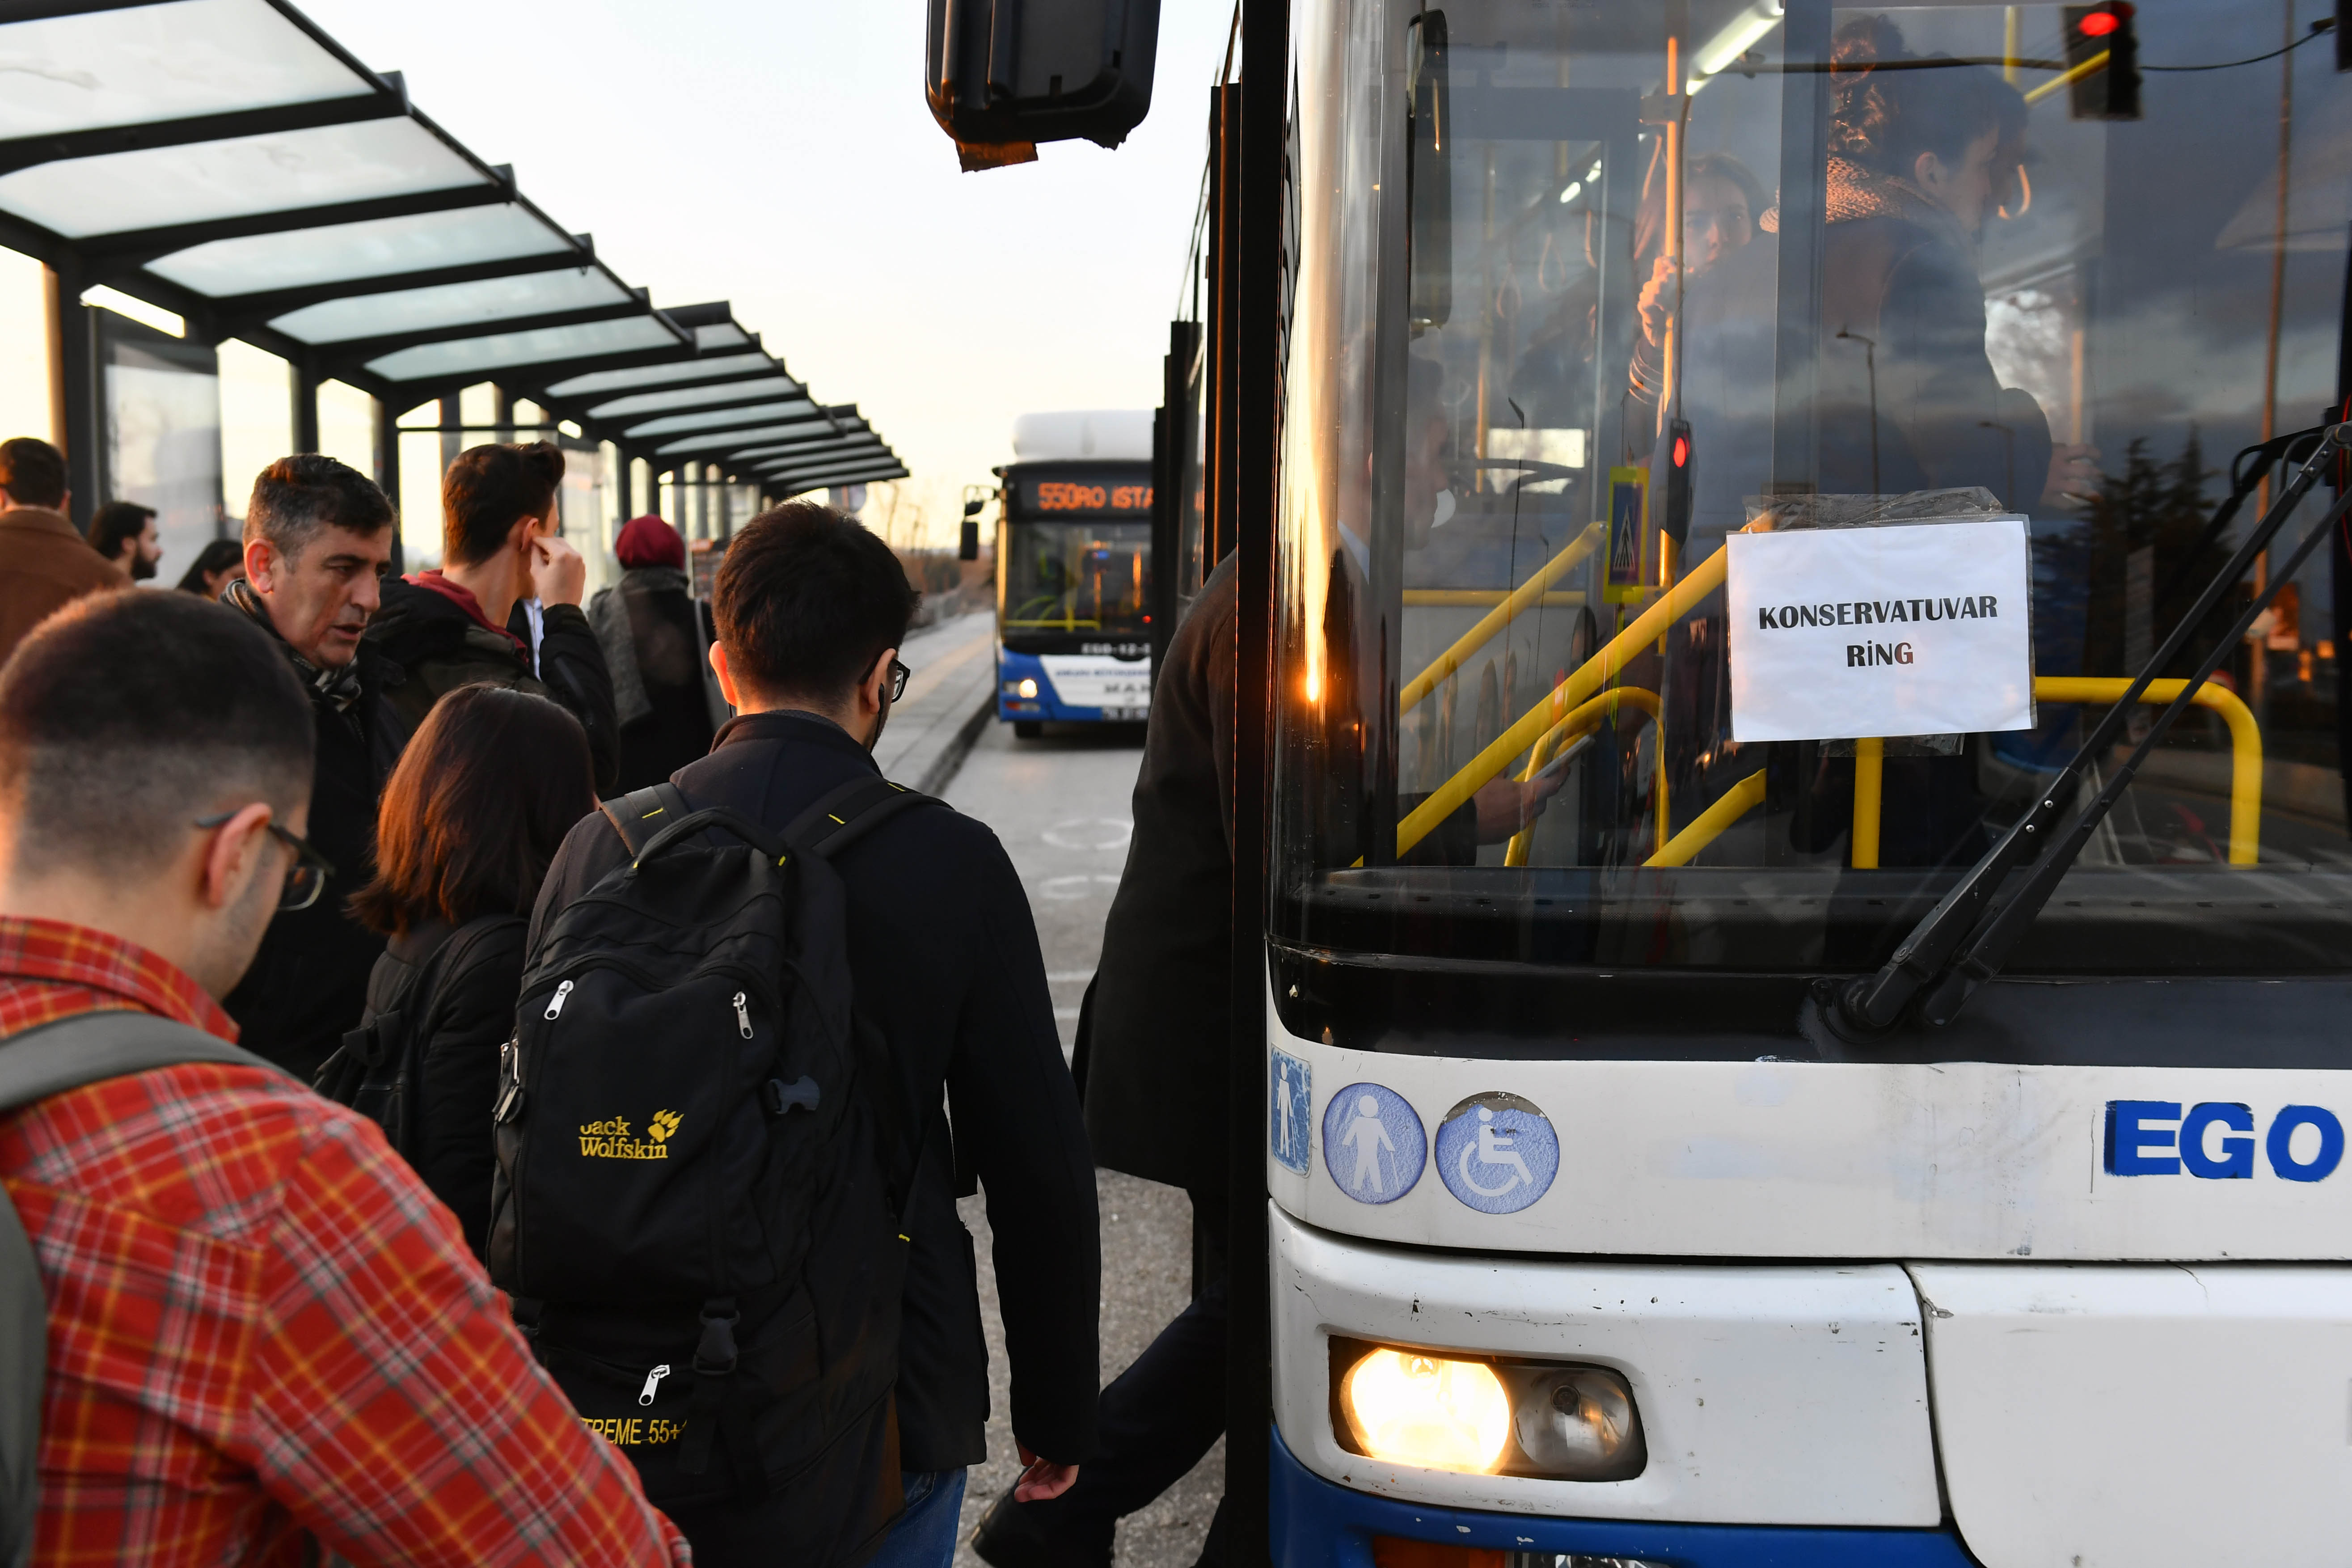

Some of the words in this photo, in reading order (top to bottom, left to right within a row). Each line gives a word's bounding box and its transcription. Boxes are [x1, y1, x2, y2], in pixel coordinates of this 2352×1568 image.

[1759, 596, 1997, 629] KONSERVATUVAR
[578, 1136, 668, 1159] Wolfskin
[2103, 1100, 2345, 1182] EGO
[648, 1419, 687, 1444] 55+
